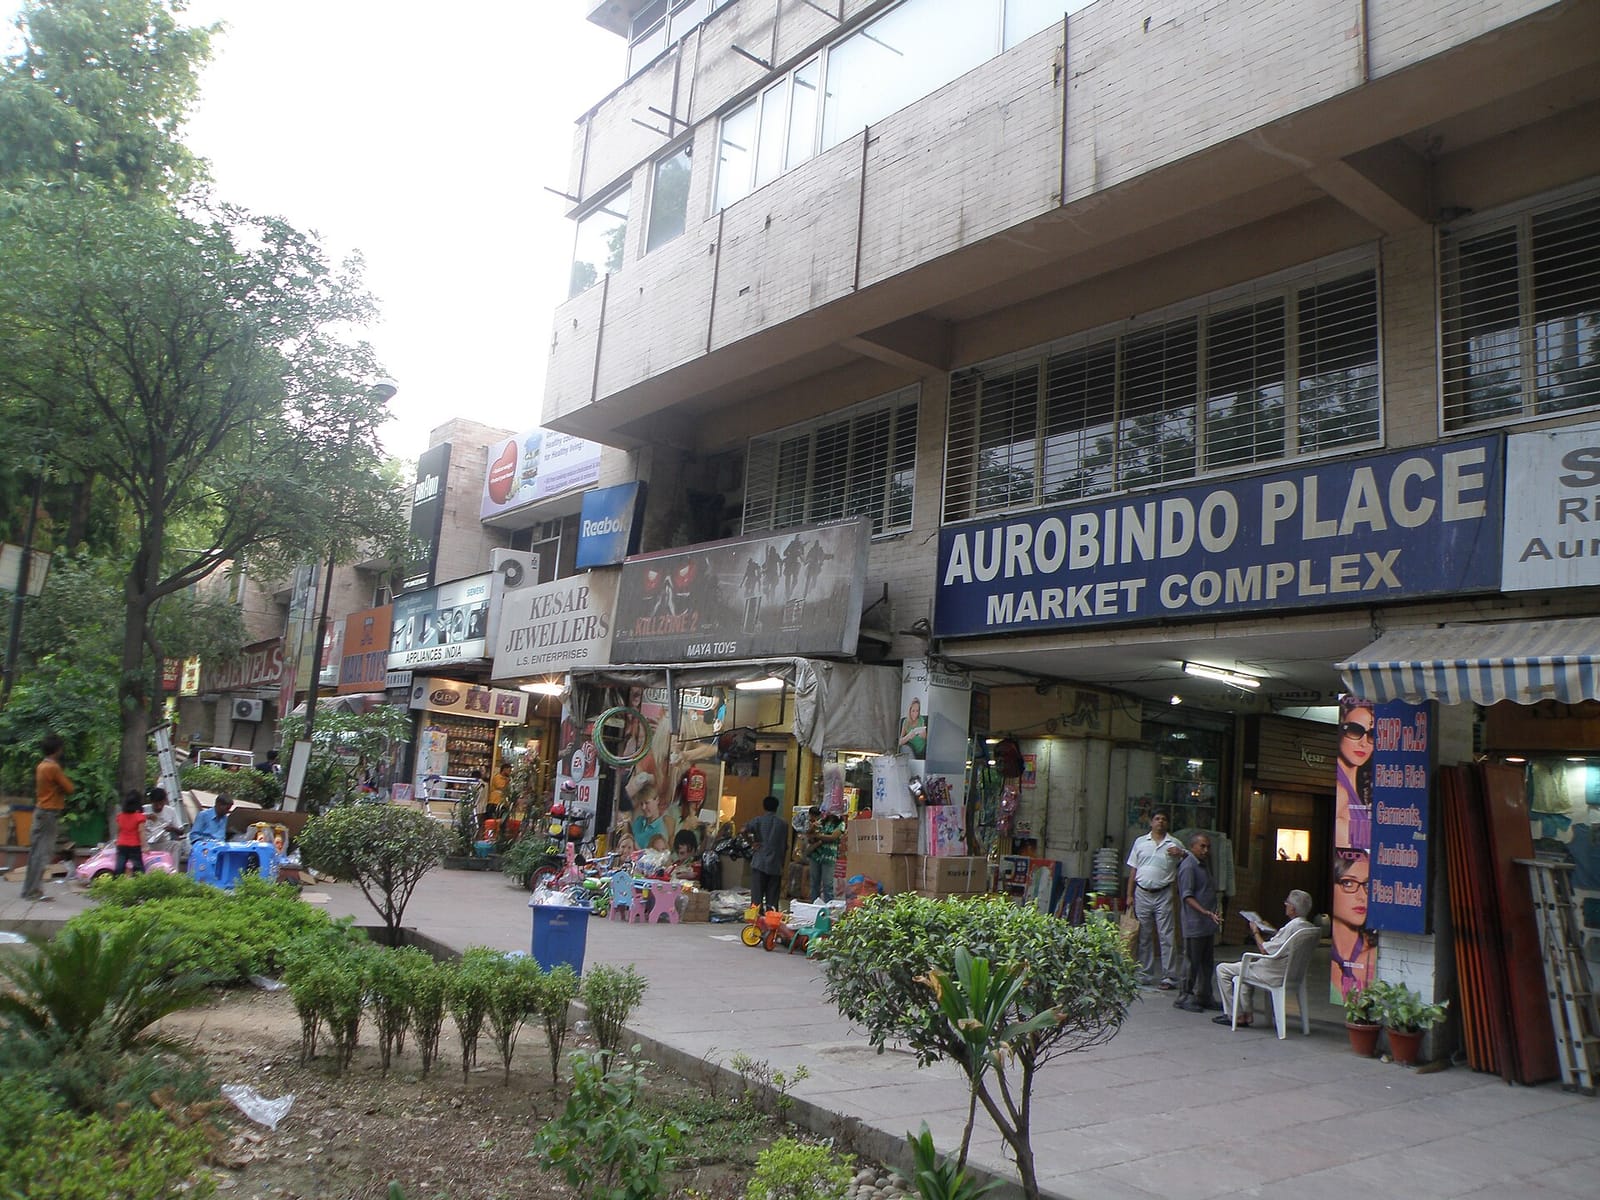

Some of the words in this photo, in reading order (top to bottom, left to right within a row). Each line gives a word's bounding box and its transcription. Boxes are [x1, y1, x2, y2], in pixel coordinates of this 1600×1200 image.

[943, 490, 1239, 586] AUROBINDO
[1260, 446, 1487, 546] PLACE
[986, 578, 1147, 625] MARKET
[1159, 549, 1402, 609] COMPLEX
[528, 586, 590, 621] KESAR
[505, 611, 610, 653] JEWELLERS
[634, 614, 689, 636] KILLZONE
[690, 611, 699, 633] 2
[405, 648, 442, 664] APPLIANCES
[445, 645, 462, 658] INDIA
[516, 657, 530, 666] L.S.
[531, 648, 589, 664] ENTERPRISES
[687, 644, 711, 657] MAYA
[713, 641, 737, 654] TOYS
[366, 651, 387, 682] TOYS
[932, 674, 970, 689] Nintendo
[1376, 717, 1401, 752] SHOP
[1301, 748, 1326, 767] Kesar
[1375, 764, 1403, 788] Richie
[1404, 764, 1426, 788] Rich
[1377, 842, 1418, 868] Aurobindo
[1372, 879, 1393, 904] Place
[1394, 881, 1422, 907] Market
